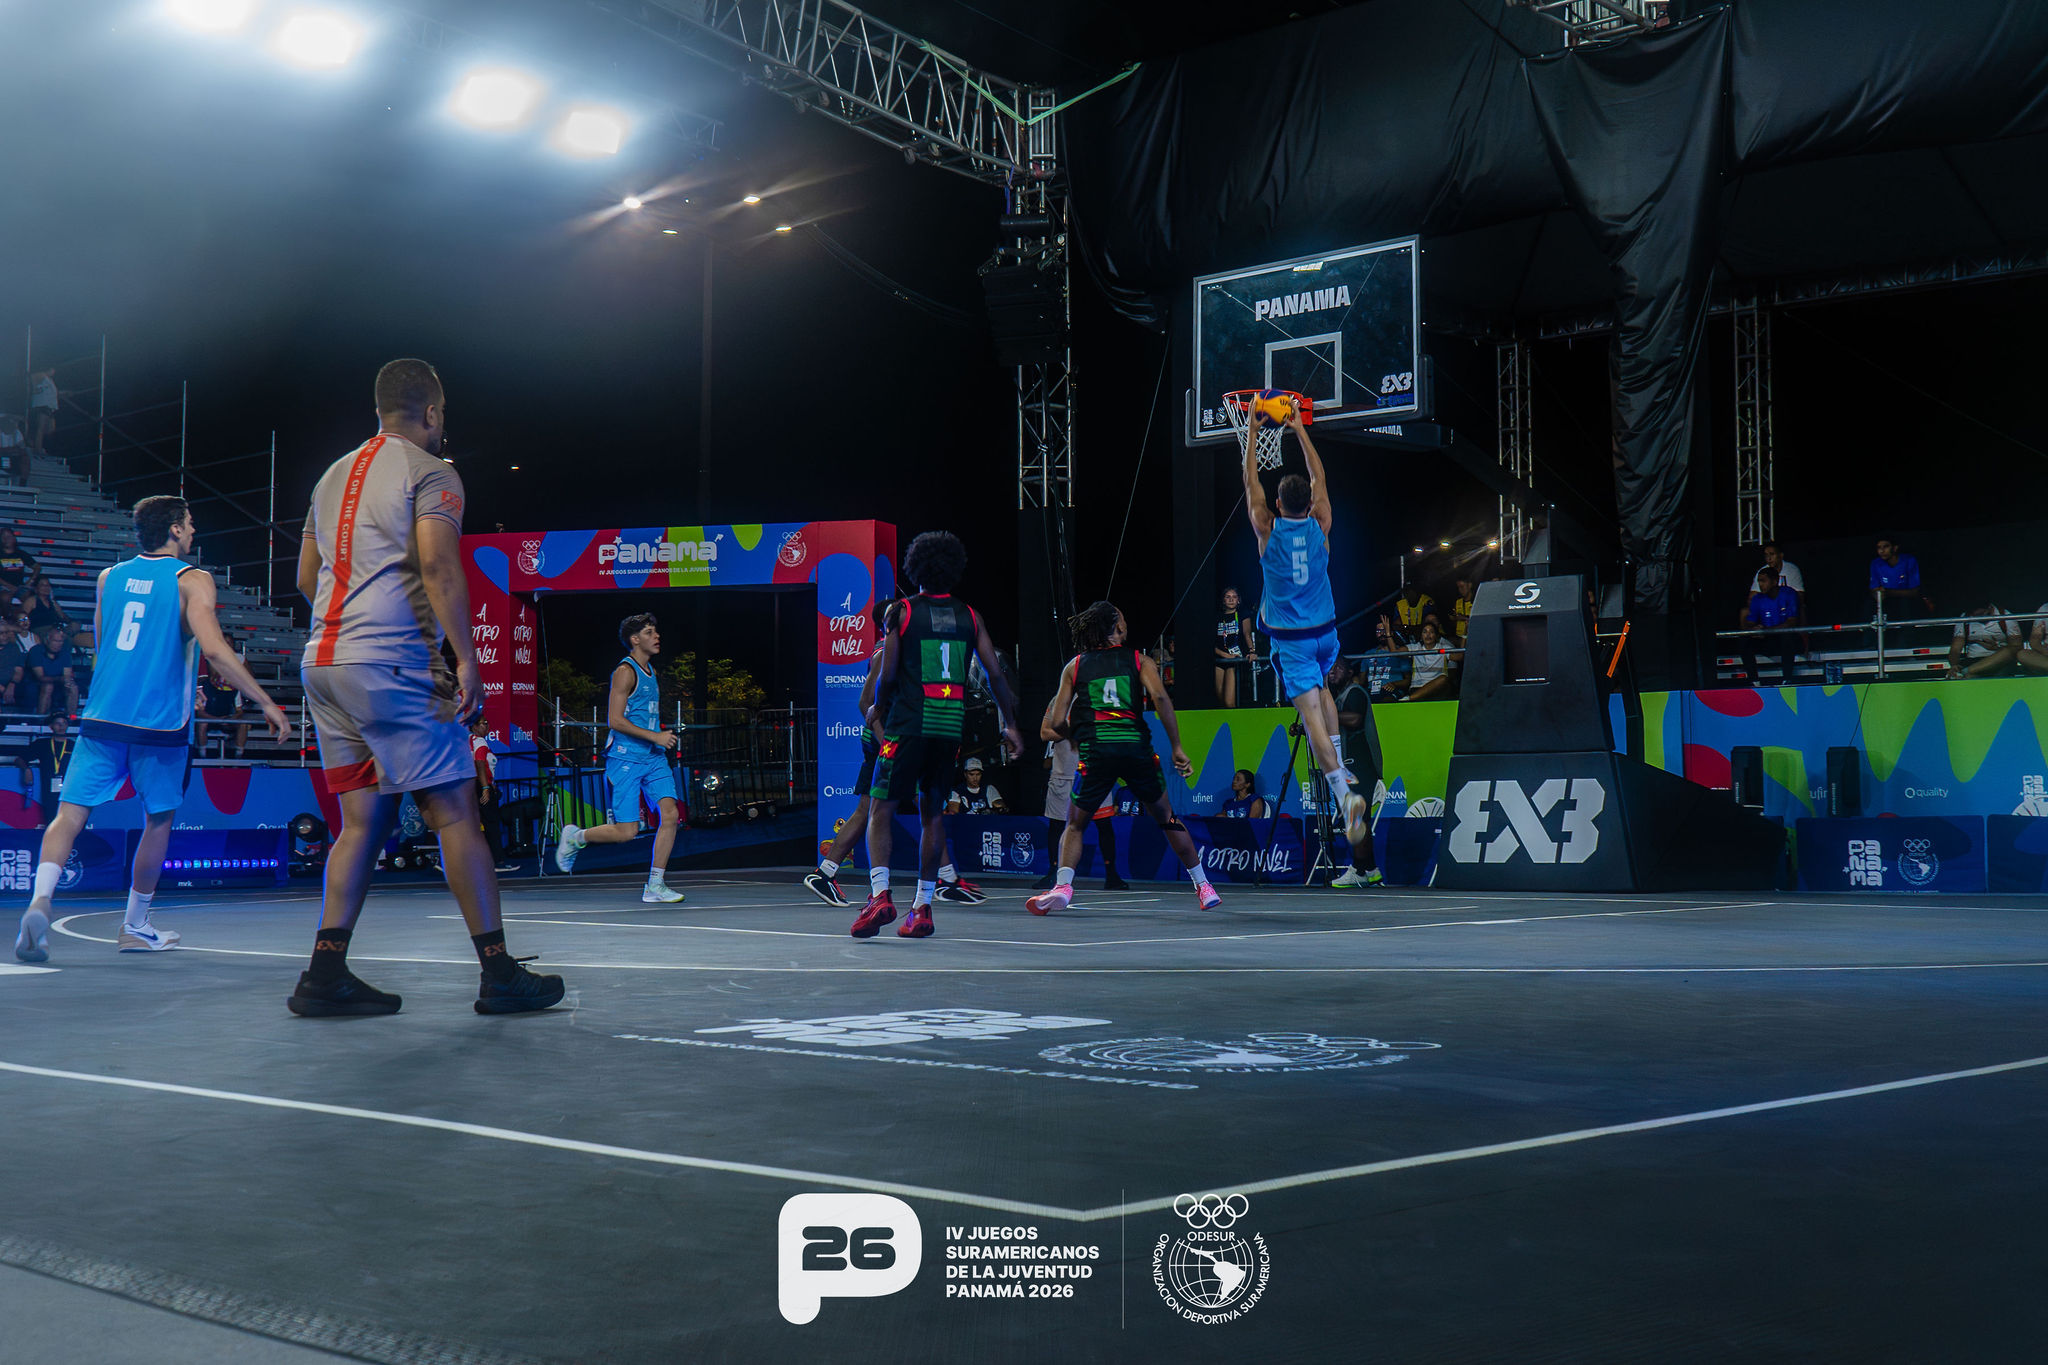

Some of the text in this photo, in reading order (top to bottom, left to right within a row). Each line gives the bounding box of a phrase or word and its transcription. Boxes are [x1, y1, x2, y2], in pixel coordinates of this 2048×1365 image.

[1255, 285, 1351, 322] PANAMA
[354, 457, 369, 476] YOU
[349, 479, 361, 495] ON
[343, 498, 357, 520] THE
[340, 523, 351, 563] COURT
[1292, 550, 1309, 586] 5
[840, 592, 852, 611] A
[476, 603, 487, 622] A
[519, 604, 525, 622] A
[116, 601, 146, 651] 6
[830, 615, 865, 632] OTRO
[514, 626, 532, 642] OTRO
[832, 635, 864, 656] NIVEL
[940, 642, 950, 679] 1
[512, 683, 535, 691] BORNAN
[1103, 679, 1120, 707] 4
[513, 730, 533, 743] ufinet
[826, 722, 864, 739] ufinet
[1192, 793, 1213, 804] ufinet
[1916, 788, 1949, 798] quality
[1208, 848, 1250, 871] OTRO
